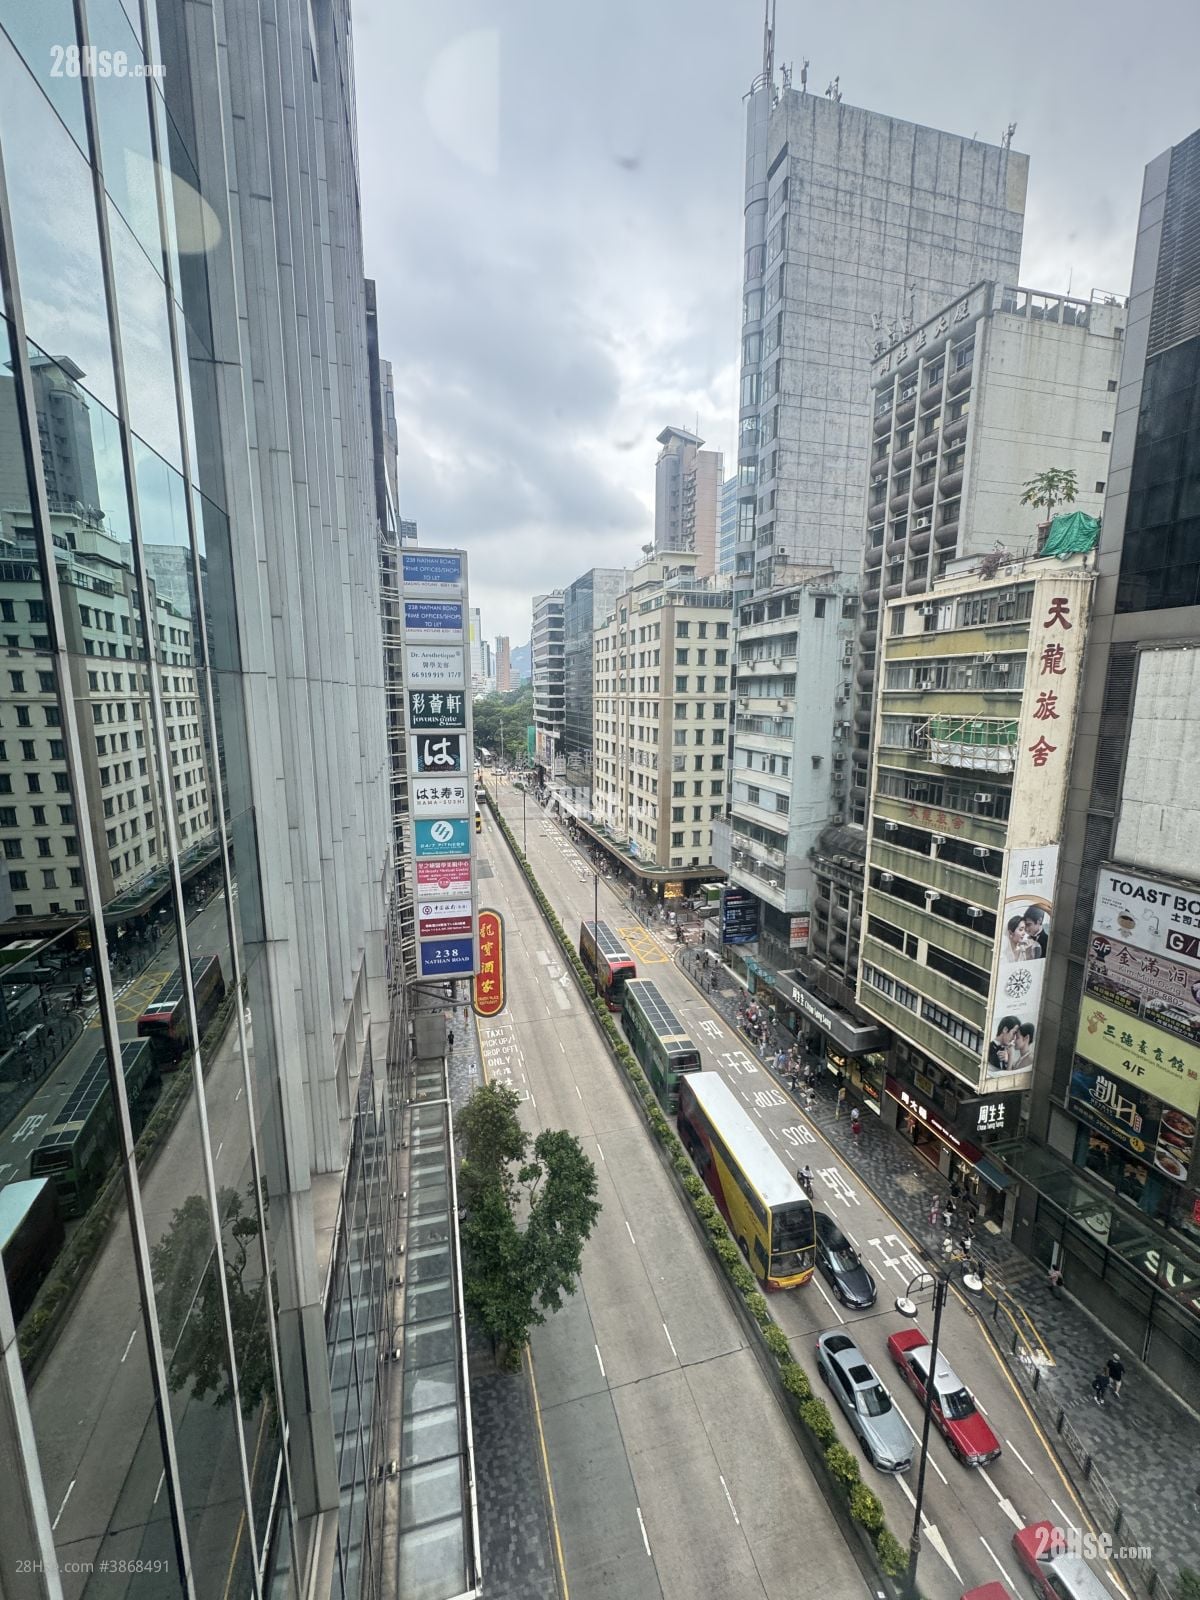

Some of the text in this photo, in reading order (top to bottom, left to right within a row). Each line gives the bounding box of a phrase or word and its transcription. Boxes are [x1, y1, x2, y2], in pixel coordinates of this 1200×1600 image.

[1029, 597, 1072, 767] 天龍旅舍
[424, 738, 455, 766] は
[417, 787, 464, 800] はま寿司
[1020, 860, 1044, 878] 周生生
[1110, 878, 1171, 907] TOAST
[435, 949, 459, 958] 238
[1093, 941, 1110, 953] 5/F
[424, 957, 451, 965] NATHAN
[1116, 947, 1187, 988] 金滿洞
[486, 1029, 504, 1038] TAXI
[484, 1045, 515, 1057] DROP OFF
[1102, 1025, 1185, 1072] 三德素食館
[488, 1056, 511, 1067] ONLY
[722, 1050, 758, 1075] 巴士
[1122, 1060, 1146, 1077] 4/F
[752, 1089, 787, 1108] STOP
[977, 1102, 1006, 1124] 周生生
[782, 1125, 817, 1146] BUS
